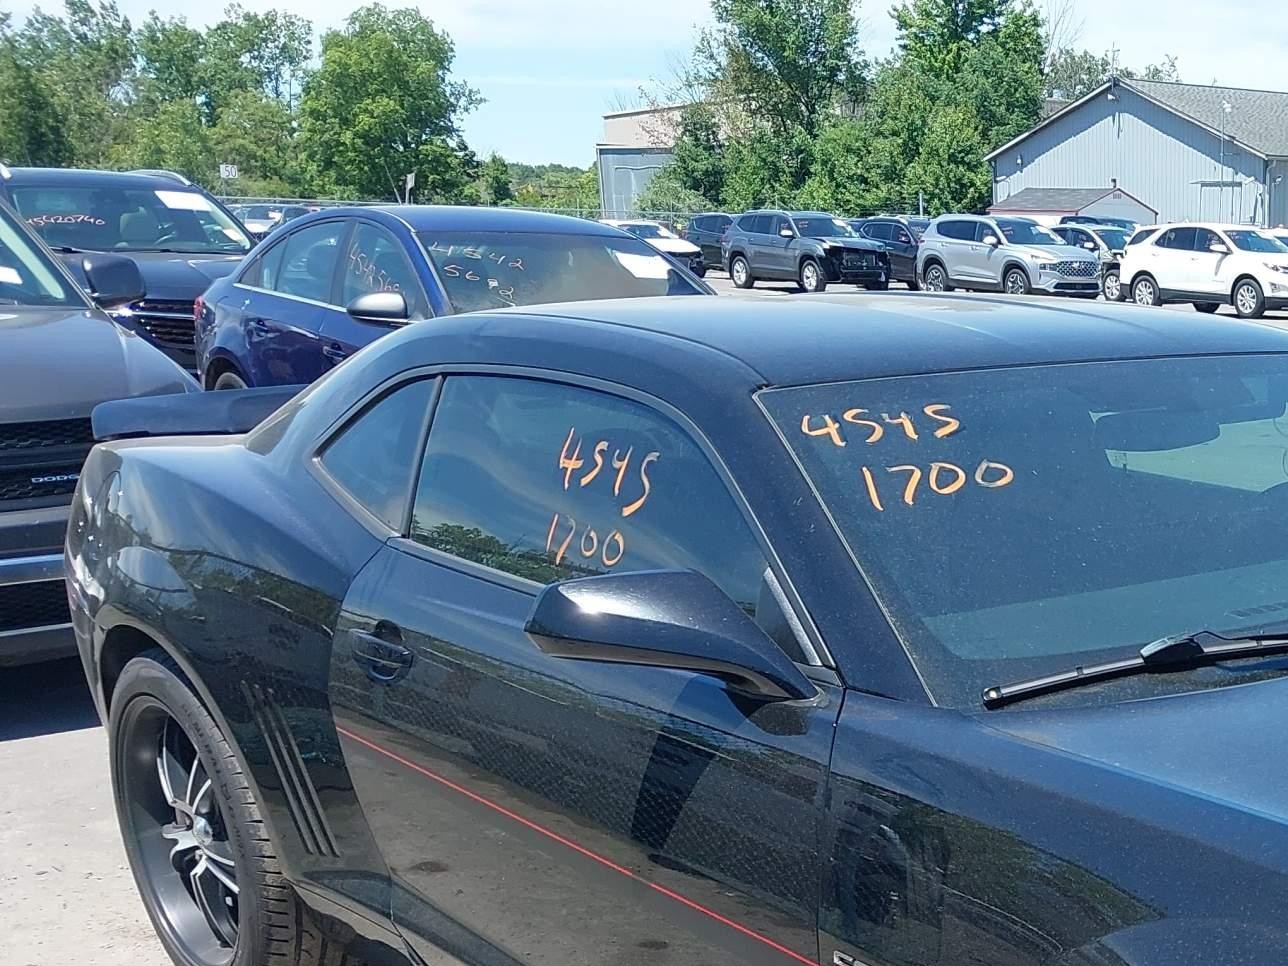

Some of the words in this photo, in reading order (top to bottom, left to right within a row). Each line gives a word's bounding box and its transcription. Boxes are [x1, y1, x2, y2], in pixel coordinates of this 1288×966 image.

[224, 165, 237, 178] 50
[800, 403, 961, 447] 4545
[31, 473, 81, 484] DODG
[559, 426, 661, 518] 4545
[860, 457, 1014, 512] 1700
[545, 512, 625, 567] 1700
